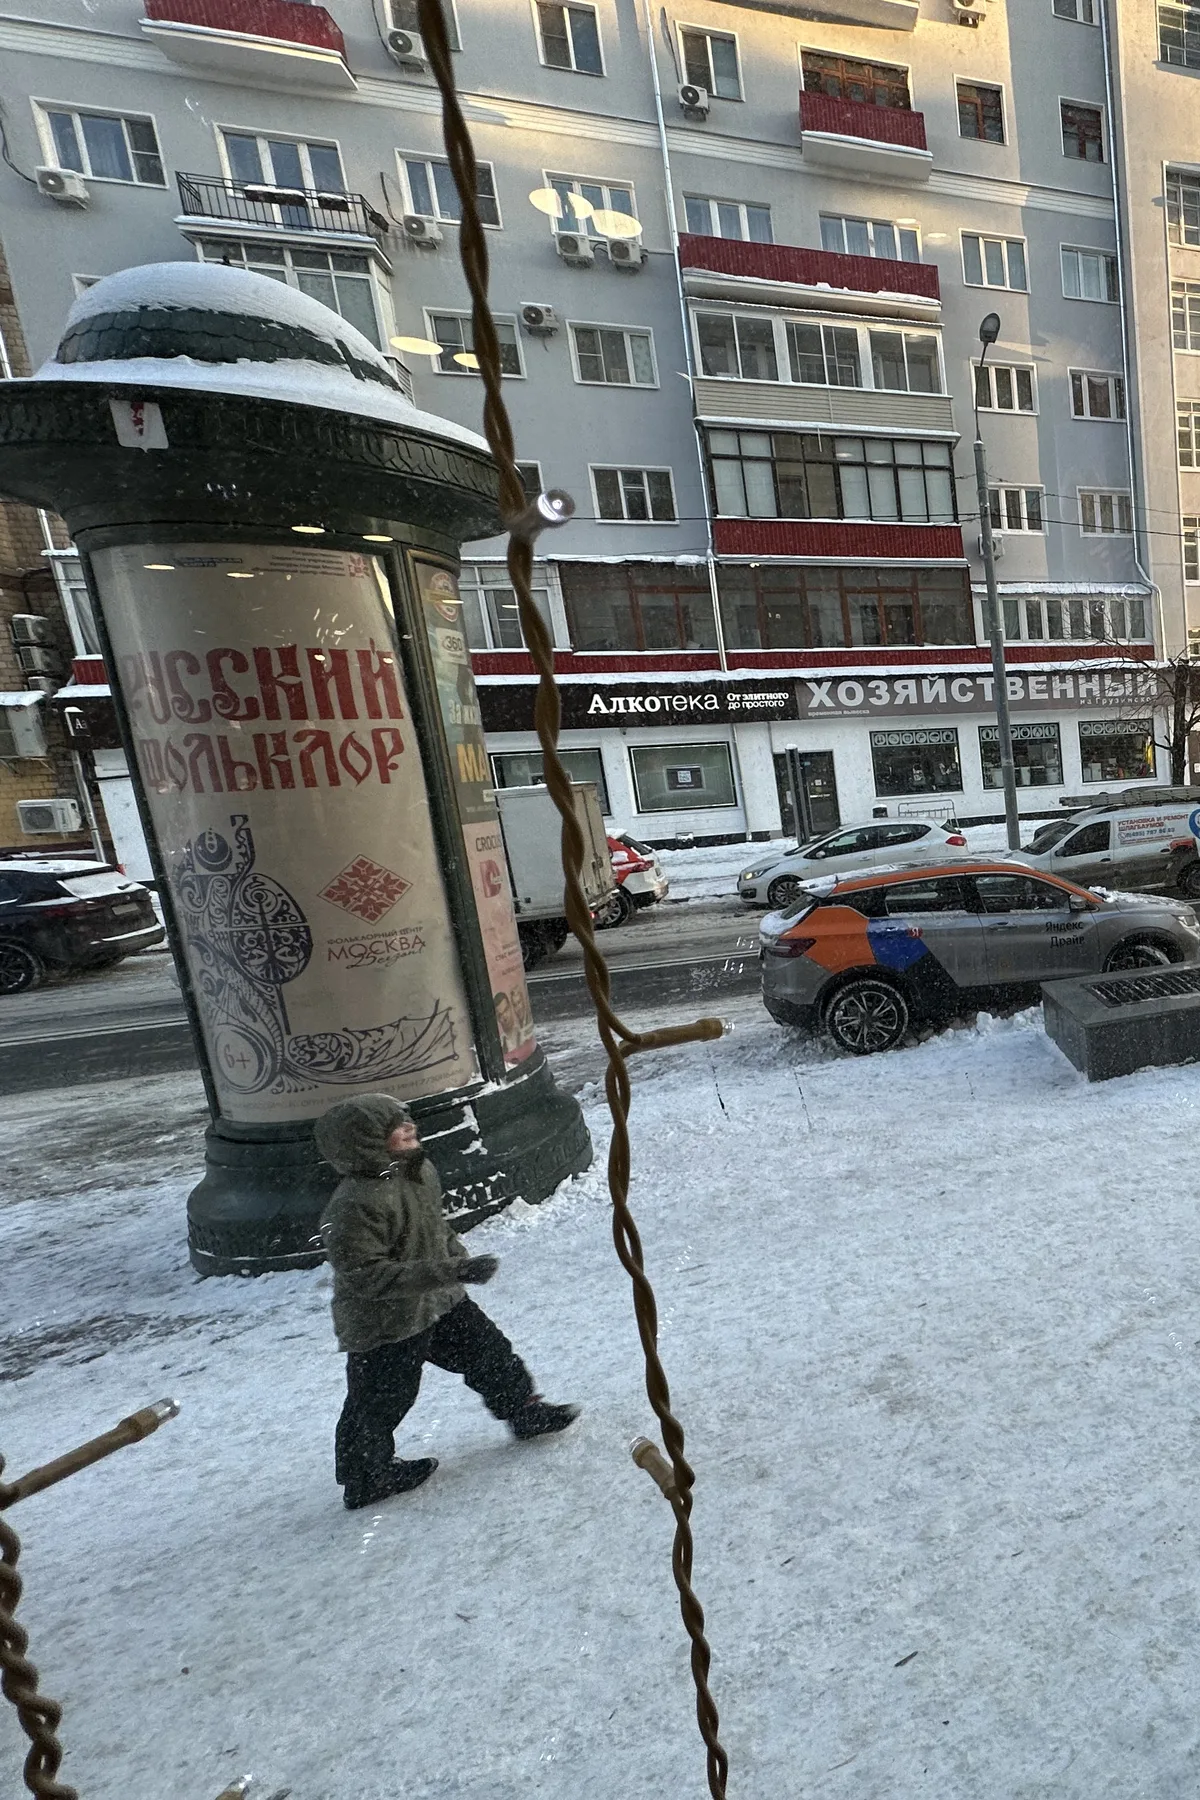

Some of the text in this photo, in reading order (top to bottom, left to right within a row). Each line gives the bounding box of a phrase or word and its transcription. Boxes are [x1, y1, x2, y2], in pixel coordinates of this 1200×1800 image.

[118, 638, 404, 725] РУССКИЙ
[807, 672, 1158, 708] ХОЗЯЙСТВЕННЫЙ
[727, 692, 789, 701] От элитного
[728, 700, 785, 710] до простого
[139, 727, 405, 795] ФОЛЬКЛОР
[1117, 817, 1156, 826] УСТАНОВКА
[1163, 813, 1189, 821] РЕМОНТ
[1118, 822, 1164, 832] ШЛАГБАУМОВ
[1045, 921, 1084, 932] Яндекс
[327, 935, 426, 961] МОСКВА
[223, 1043, 251, 1069] 6+
